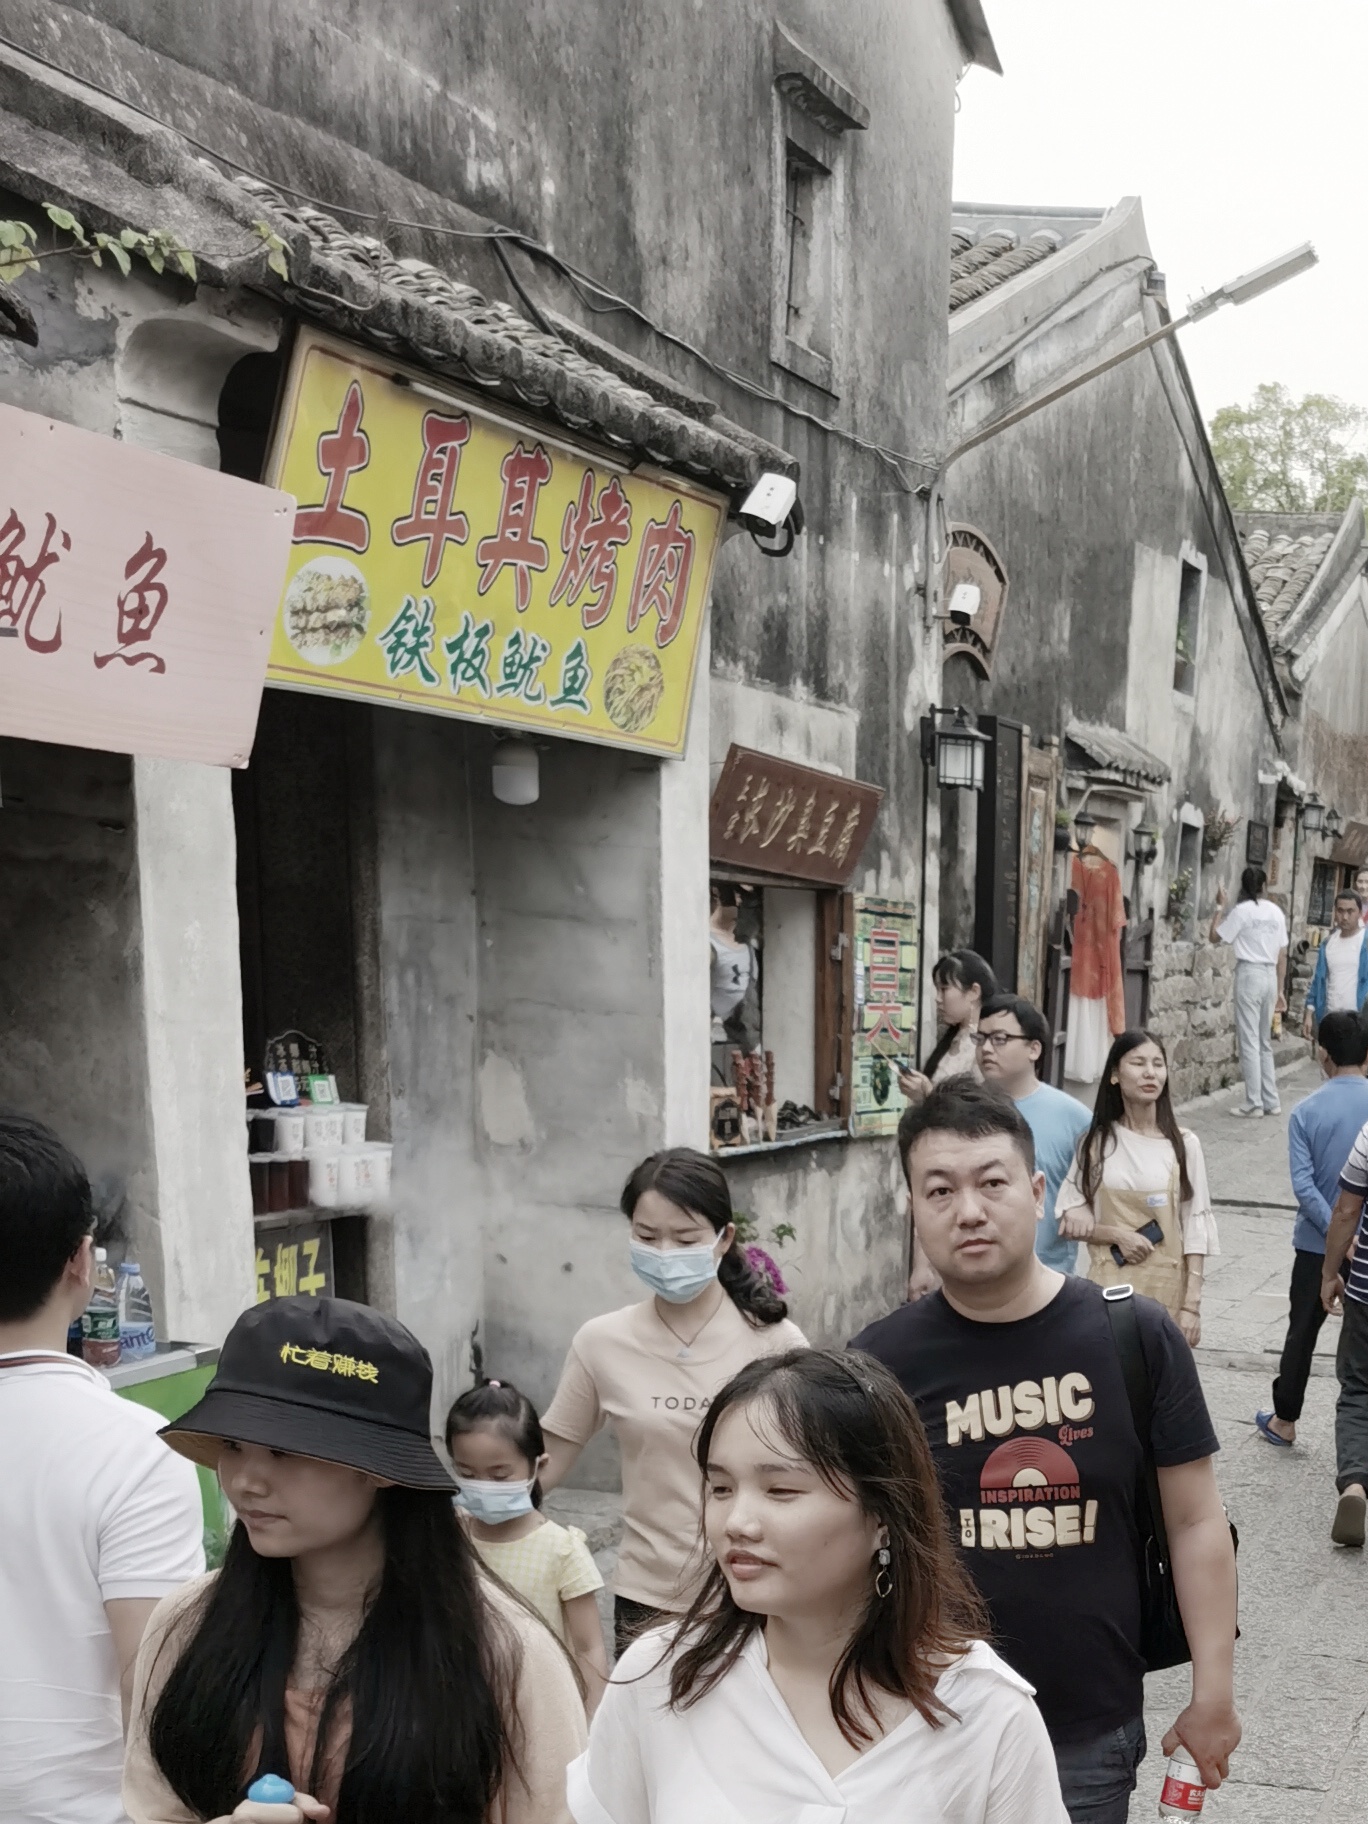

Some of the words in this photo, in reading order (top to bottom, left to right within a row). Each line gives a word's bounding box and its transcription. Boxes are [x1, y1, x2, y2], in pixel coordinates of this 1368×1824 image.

[292, 380, 695, 648] 土耳其烤肉
[377, 597, 590, 714] 铁板鱿鱼
[280, 1342, 379, 1384] 忙着赚钱
[652, 1396, 715, 1410] TODA
[946, 1372, 1095, 1446] MUSIC
[1058, 1424, 1094, 1446] Gives
[980, 1486, 1080, 1503] INSPIRATION
[979, 1500, 1098, 1550] RISE!
